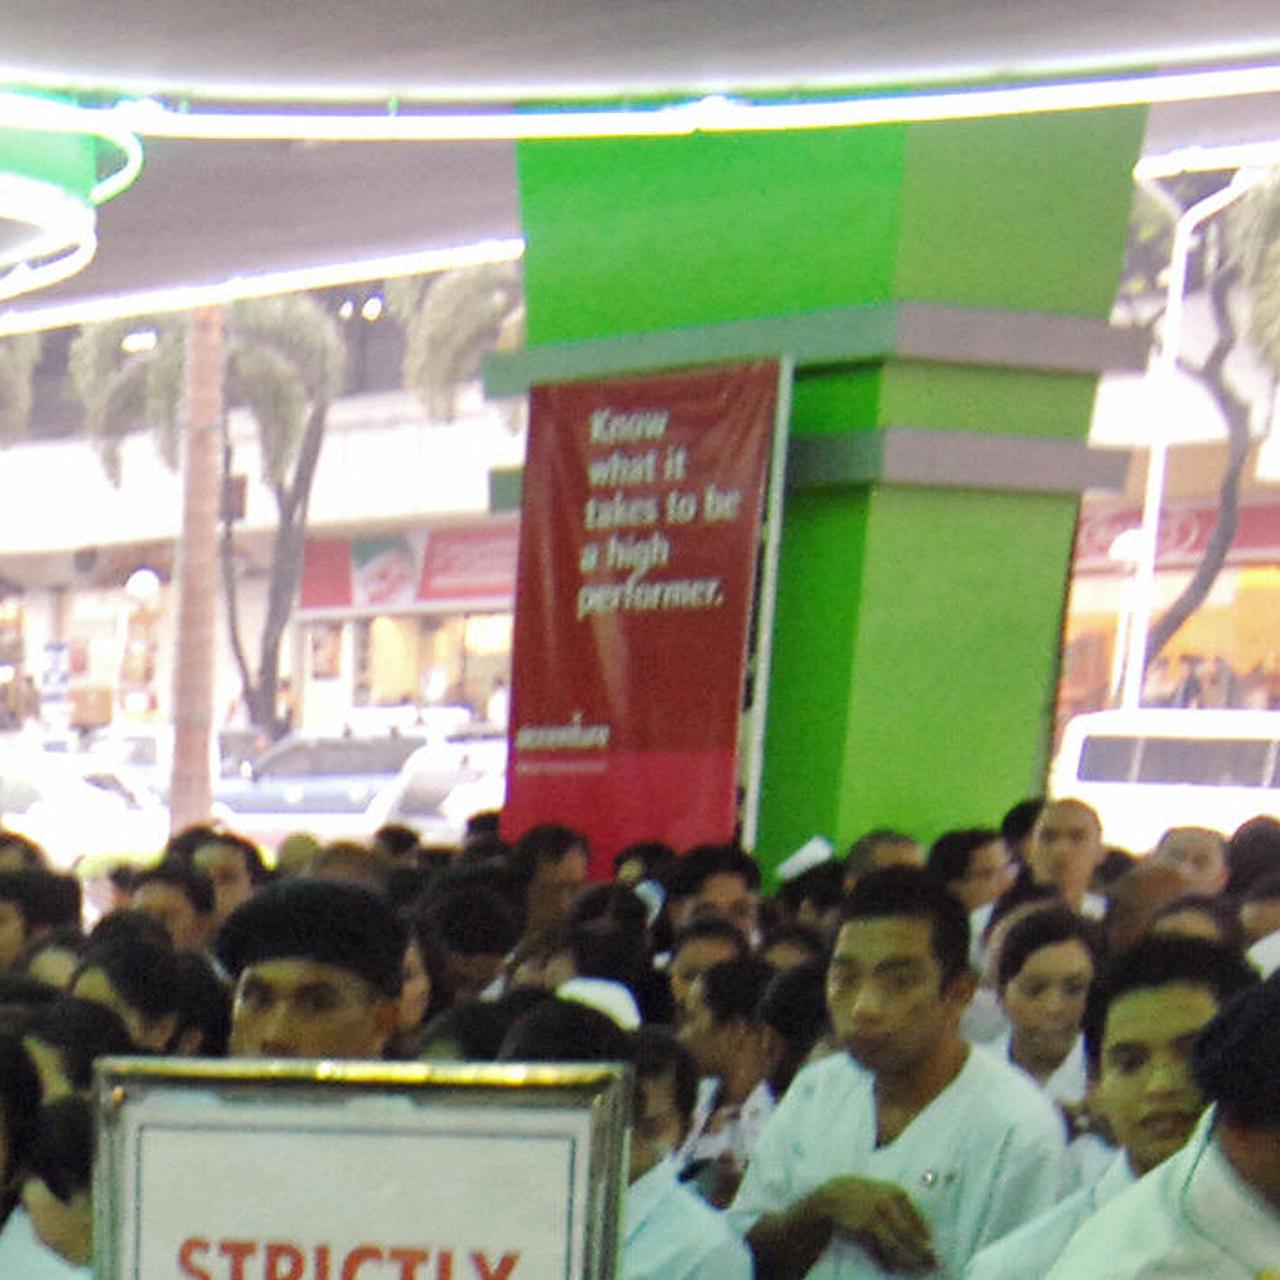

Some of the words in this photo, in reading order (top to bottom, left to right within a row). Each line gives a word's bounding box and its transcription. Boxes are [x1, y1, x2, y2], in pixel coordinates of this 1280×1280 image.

[591, 409, 668, 443] Know
[589, 449, 656, 486] what
[667, 490, 697, 523] to
[705, 484, 741, 520] be
